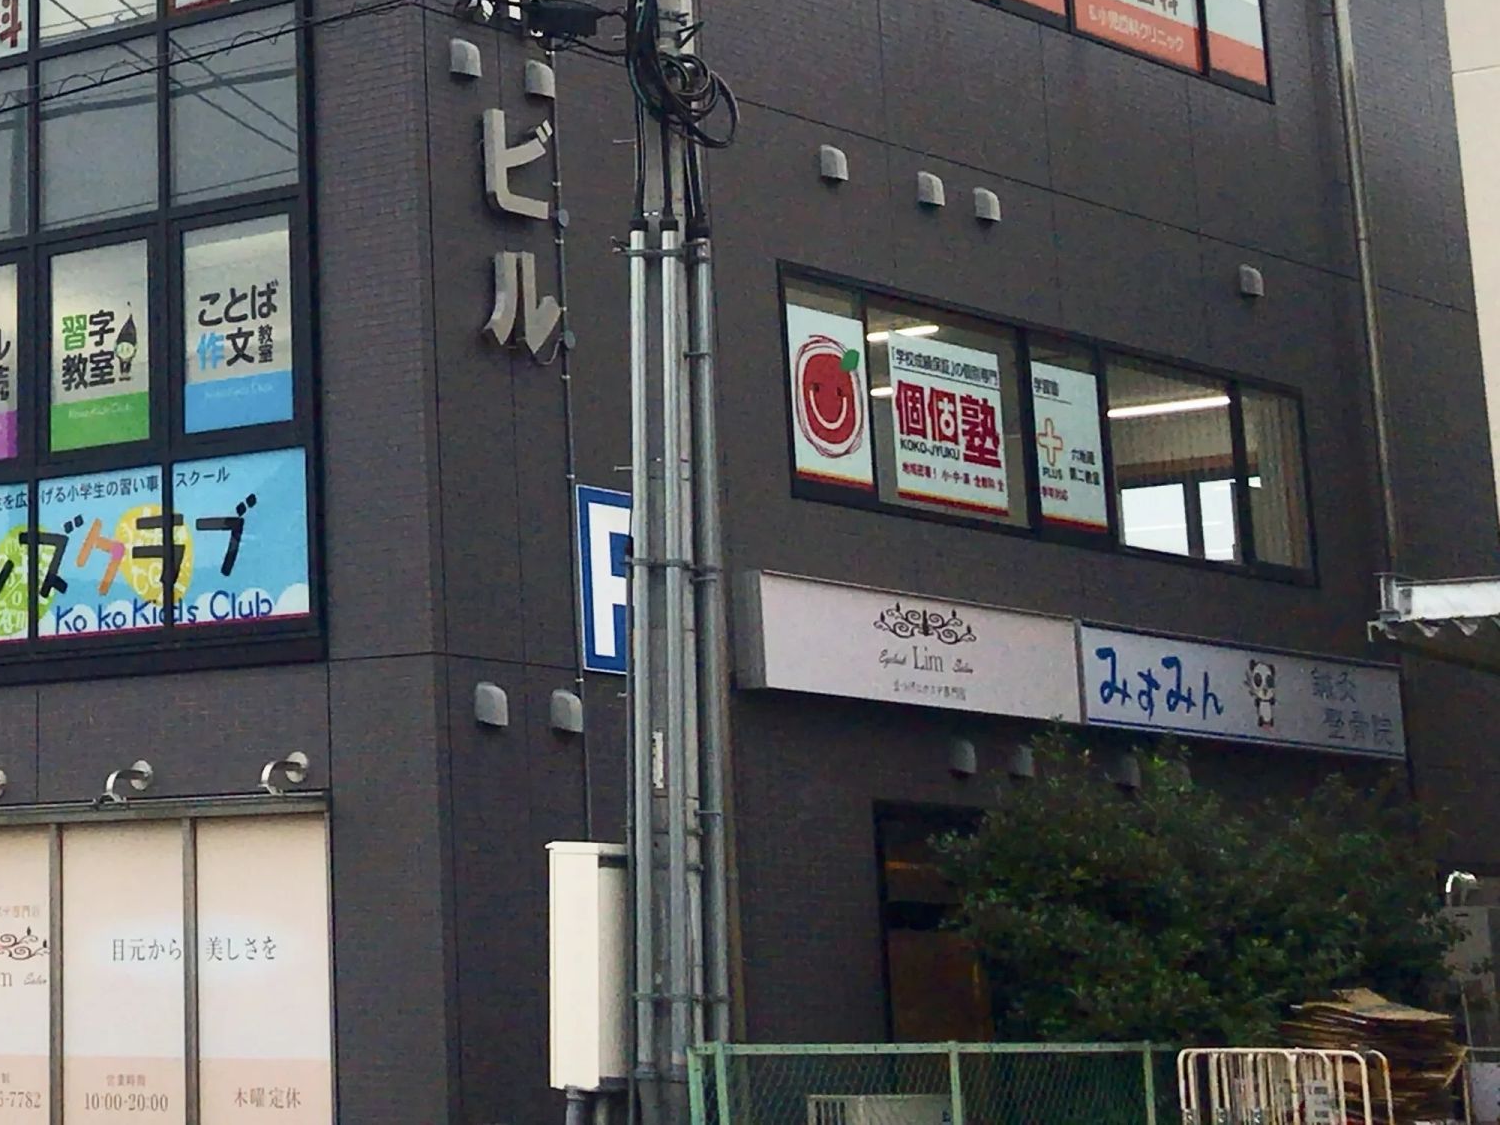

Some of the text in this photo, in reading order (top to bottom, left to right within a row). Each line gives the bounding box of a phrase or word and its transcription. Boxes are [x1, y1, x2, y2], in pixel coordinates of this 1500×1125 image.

[198, 278, 279, 327] ことば
[62, 309, 116, 351] 習字
[61, 349, 116, 392] 教室
[209, 589, 274, 625] Club
[912, 645, 944, 673] Lim
[110, 935, 278, 962] 目元から 美しさを
